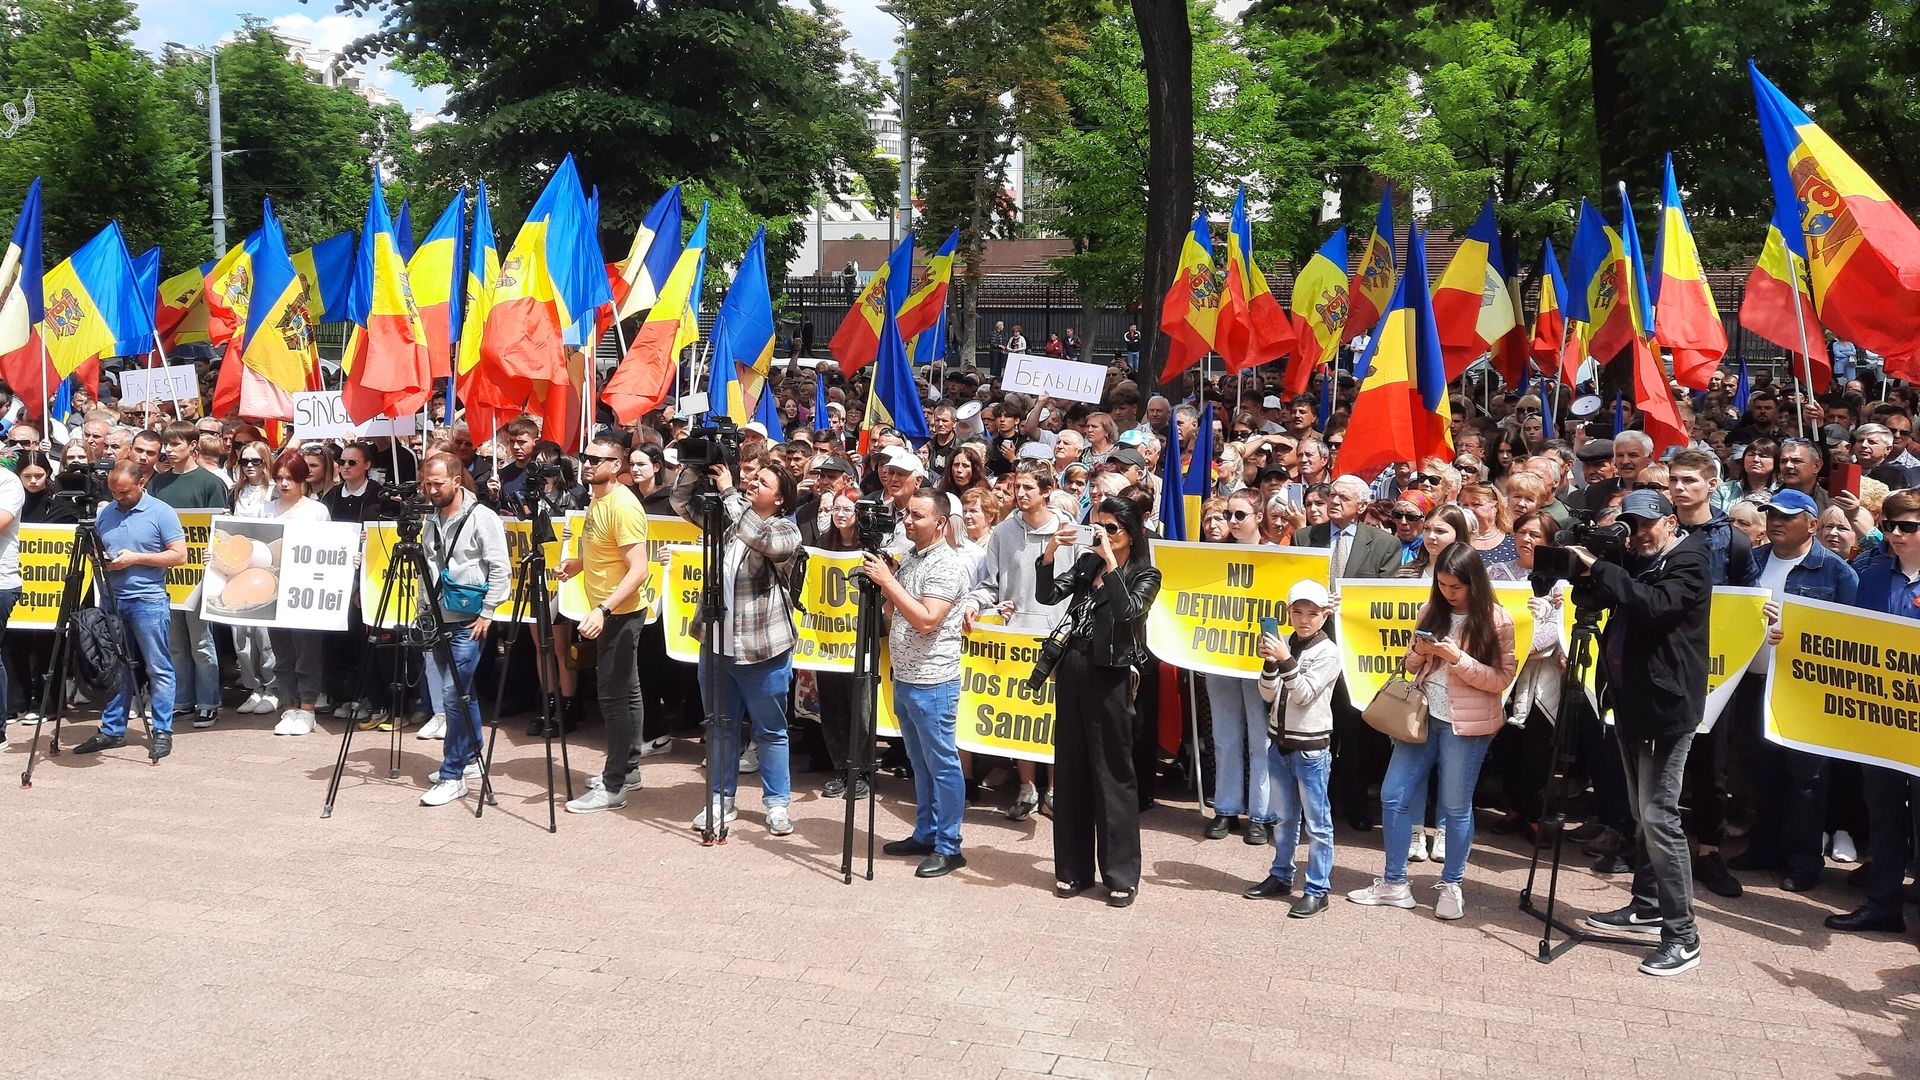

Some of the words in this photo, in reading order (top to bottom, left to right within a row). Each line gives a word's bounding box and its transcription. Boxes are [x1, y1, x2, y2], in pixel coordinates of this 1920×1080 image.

[292, 545, 313, 564] 10
[316, 546, 347, 566] ouă
[1227, 562, 1254, 589] NU
[287, 587, 313, 610] 30
[318, 588, 343, 611] lei
[1176, 592, 1293, 630] DEȚINUȚILO
[1370, 602, 1394, 620] NU
[1800, 632, 1880, 668] REGIMUL
[961, 667, 1001, 697] Jos
[1791, 658, 1888, 699] SCUMPIRI,
[1891, 678, 1920, 704] SĂ
[1823, 692, 1920, 732] DISTRUGE
